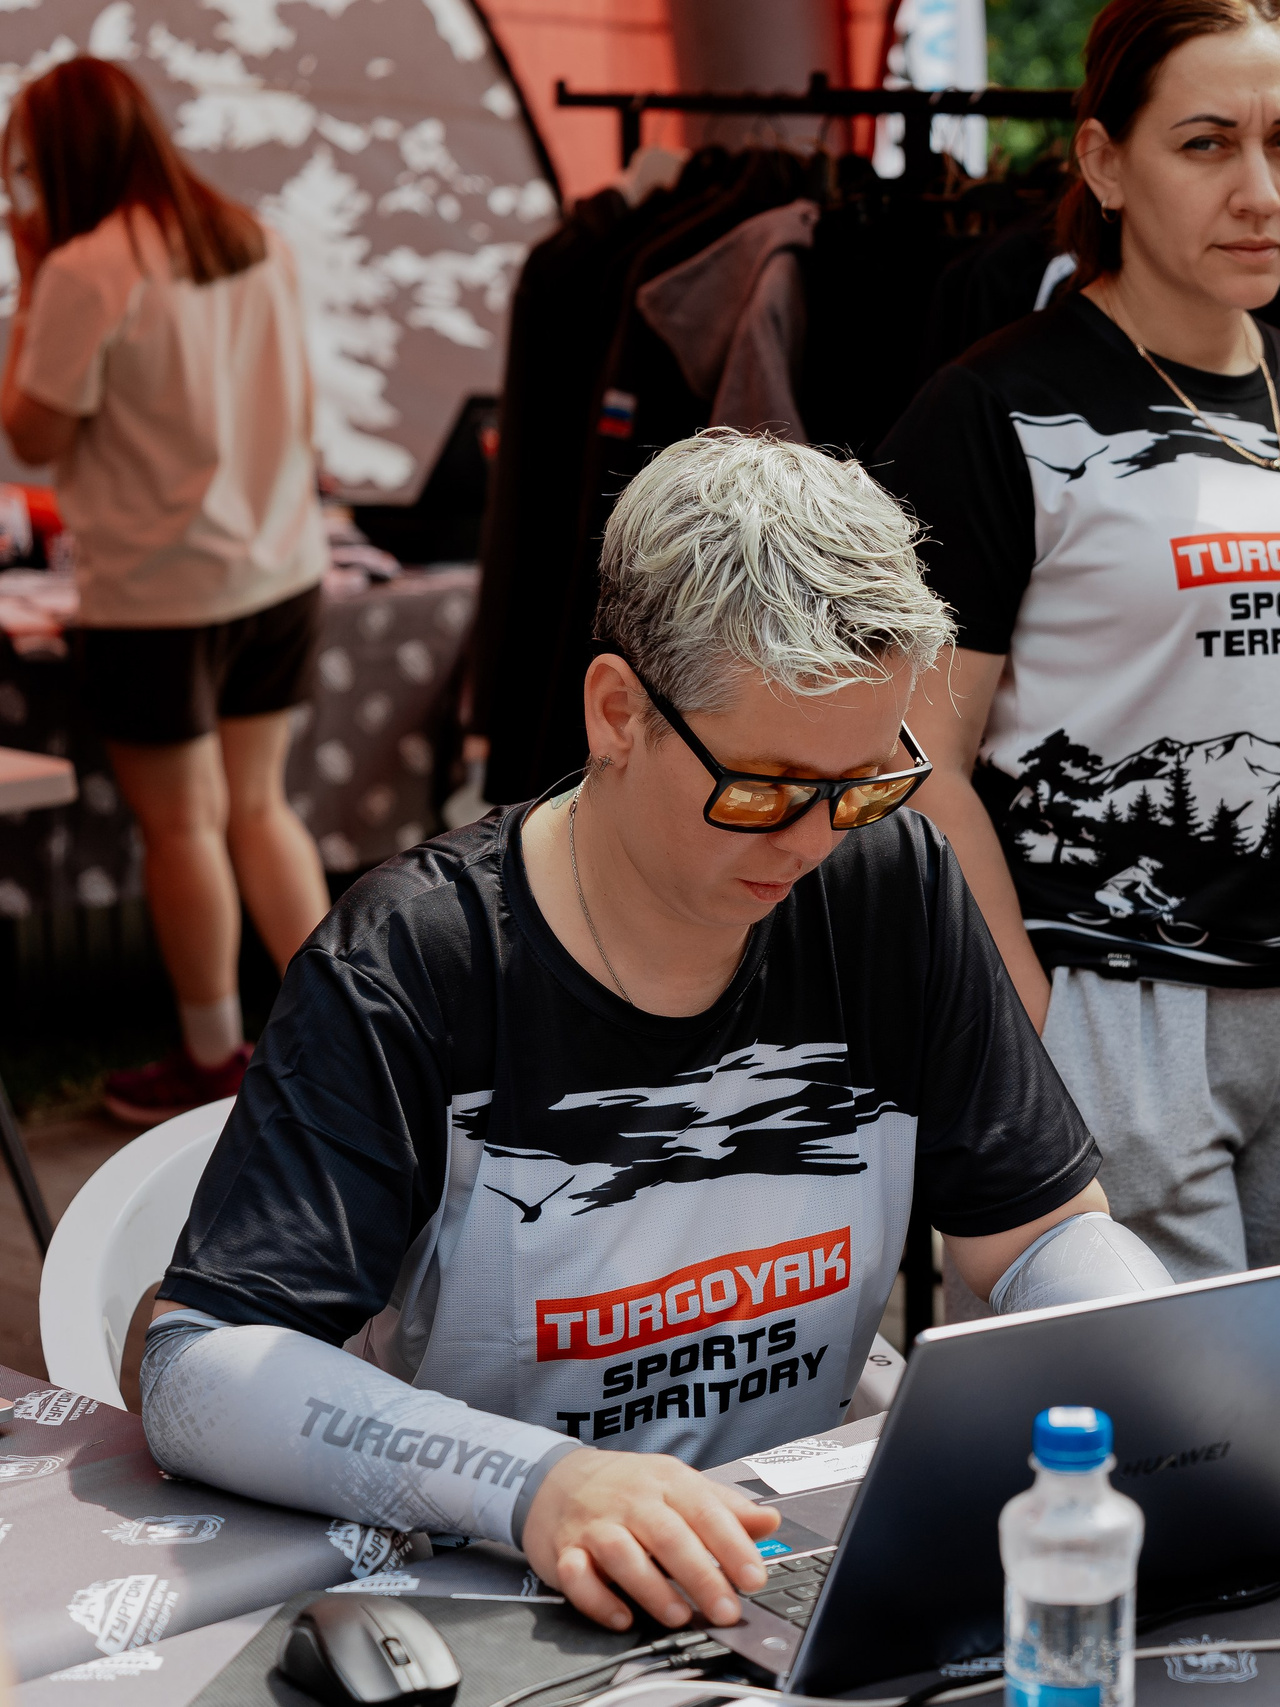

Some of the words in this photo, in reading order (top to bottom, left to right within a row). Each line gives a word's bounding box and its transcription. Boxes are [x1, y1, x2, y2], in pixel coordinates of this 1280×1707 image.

[543, 1240, 848, 1351] TURGOYAK
[556, 1344, 830, 1441] TERRITORY
[602, 1318, 798, 1400] SPORTS
[299, 1396, 538, 1489] TURGOYAK
[1121, 1440, 1231, 1478] HUAWEI
